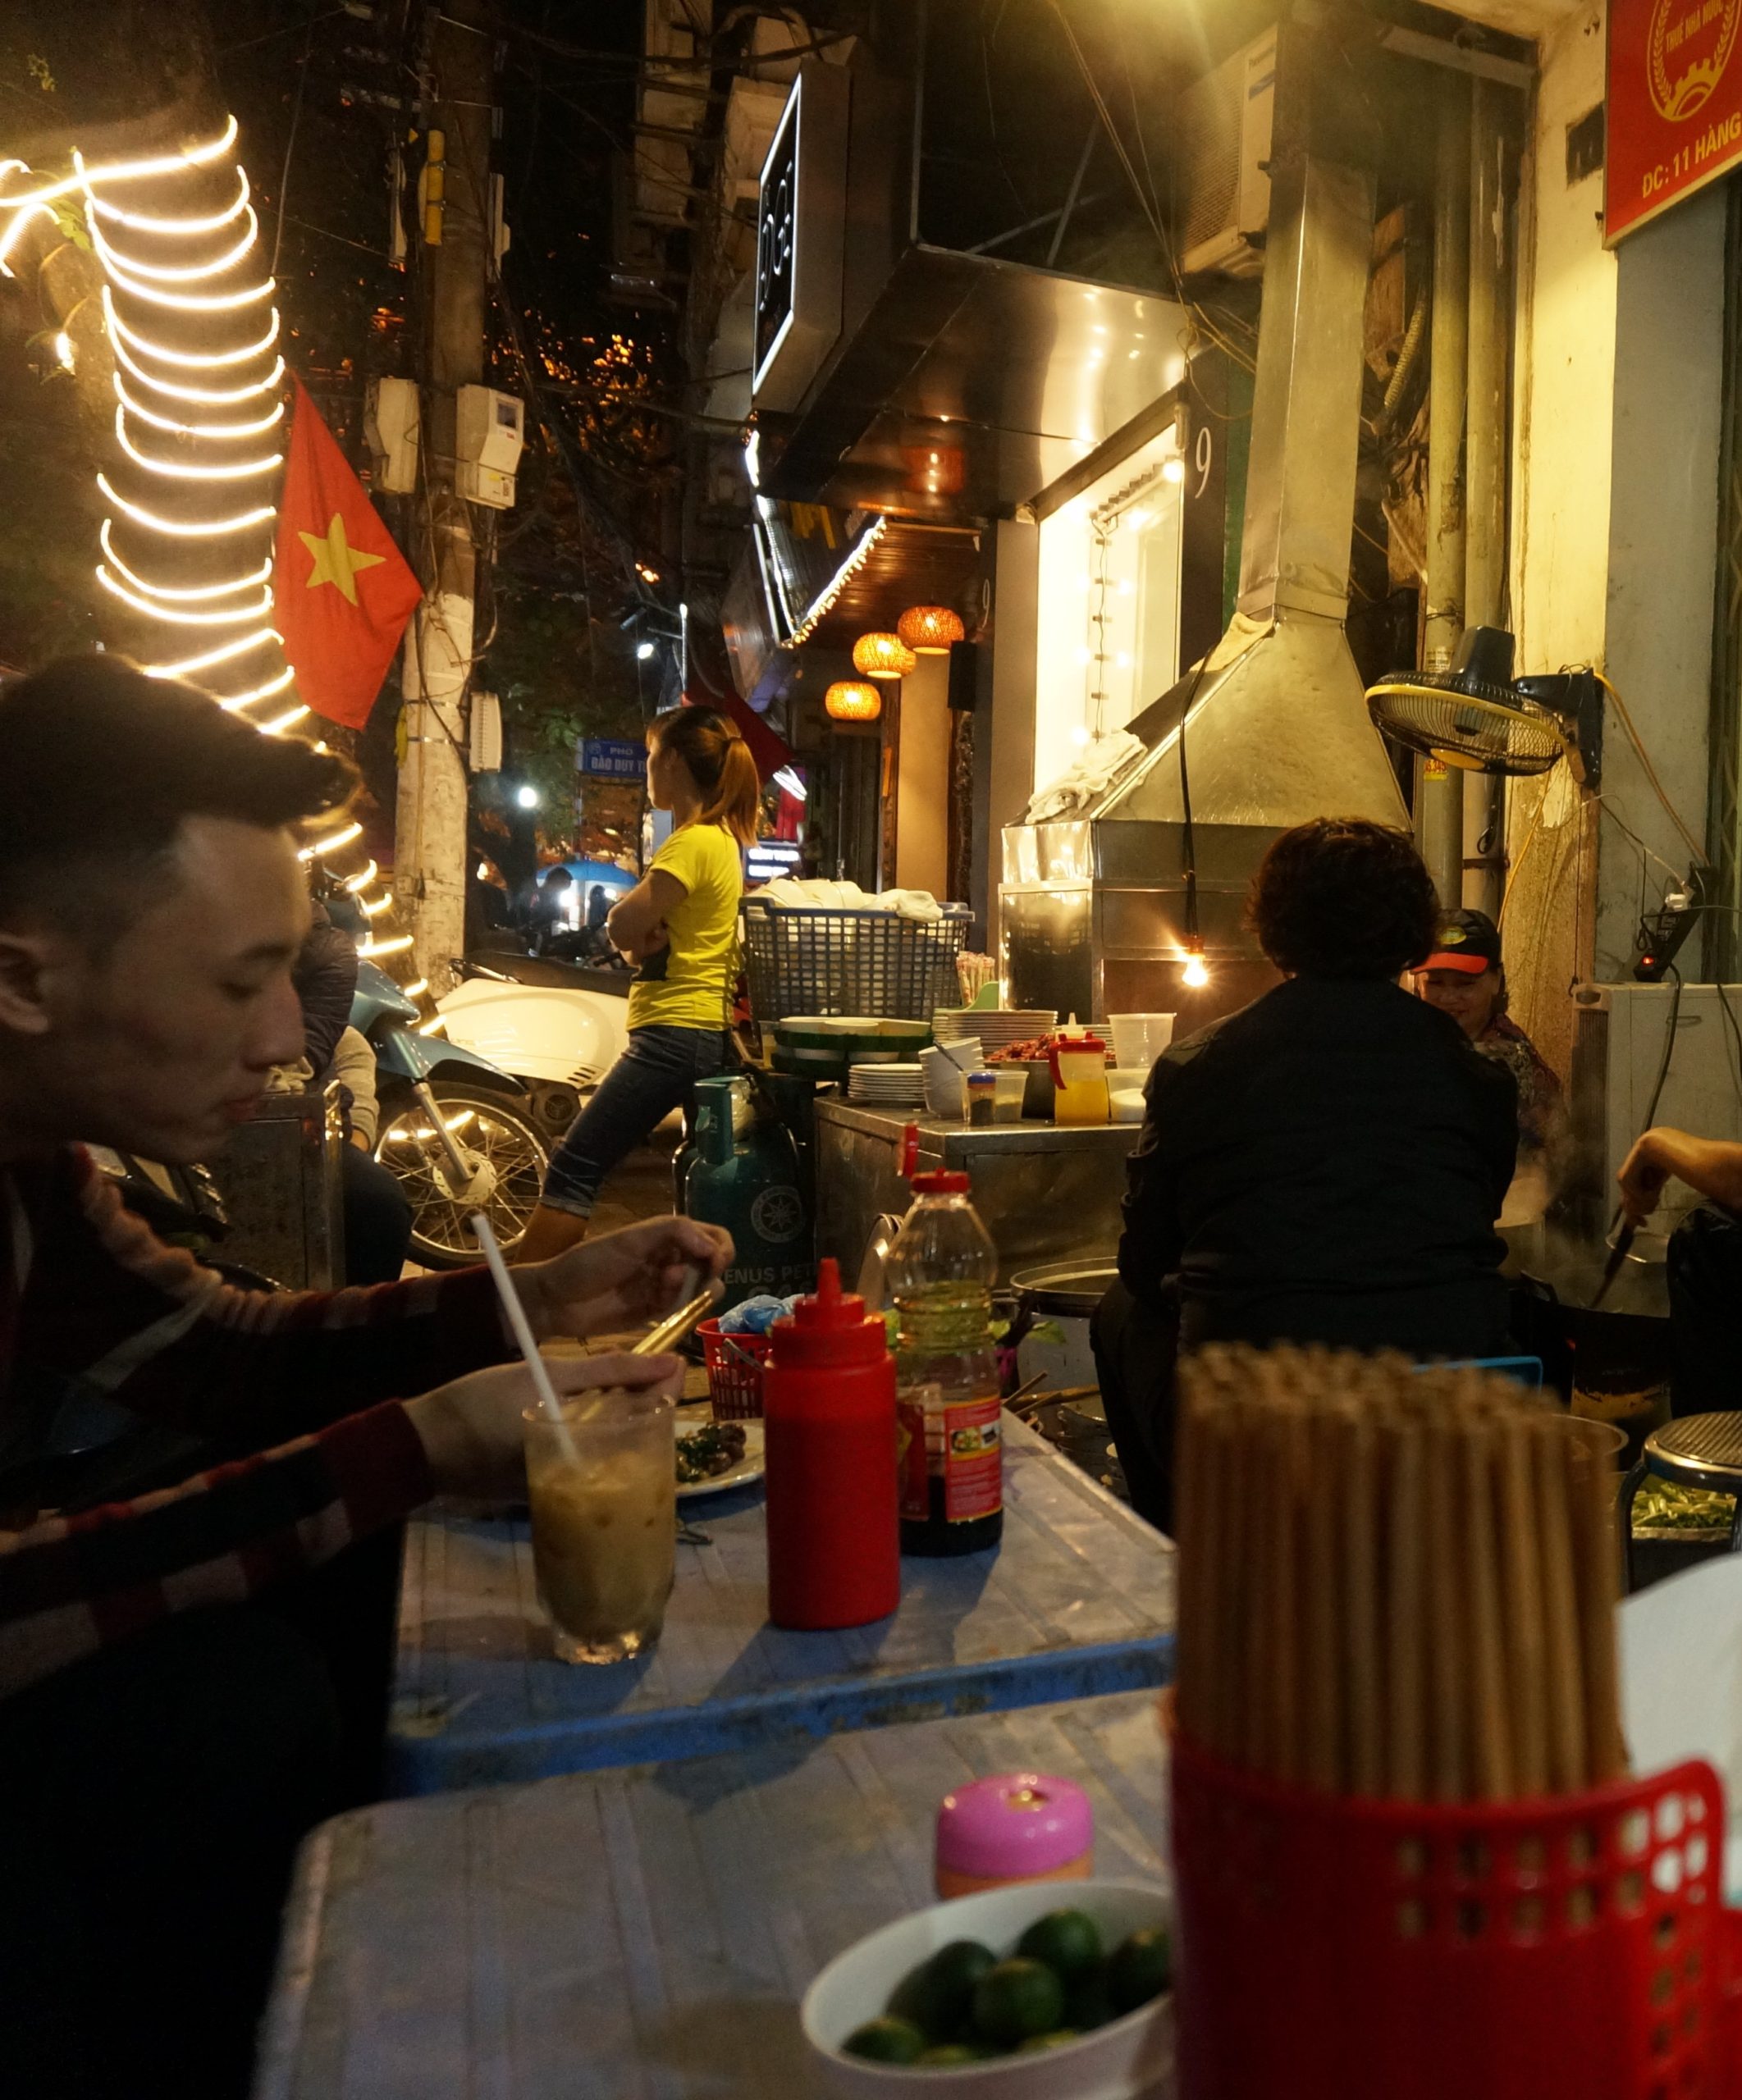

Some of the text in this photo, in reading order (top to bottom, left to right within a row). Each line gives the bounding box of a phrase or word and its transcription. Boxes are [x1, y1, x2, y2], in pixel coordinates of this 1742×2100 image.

[1673, 146, 1689, 178] 11
[1694, 112, 1741, 165] HÀNG
[1195, 427, 1212, 500] 9
[721, 1267, 775, 1285] ENUS
